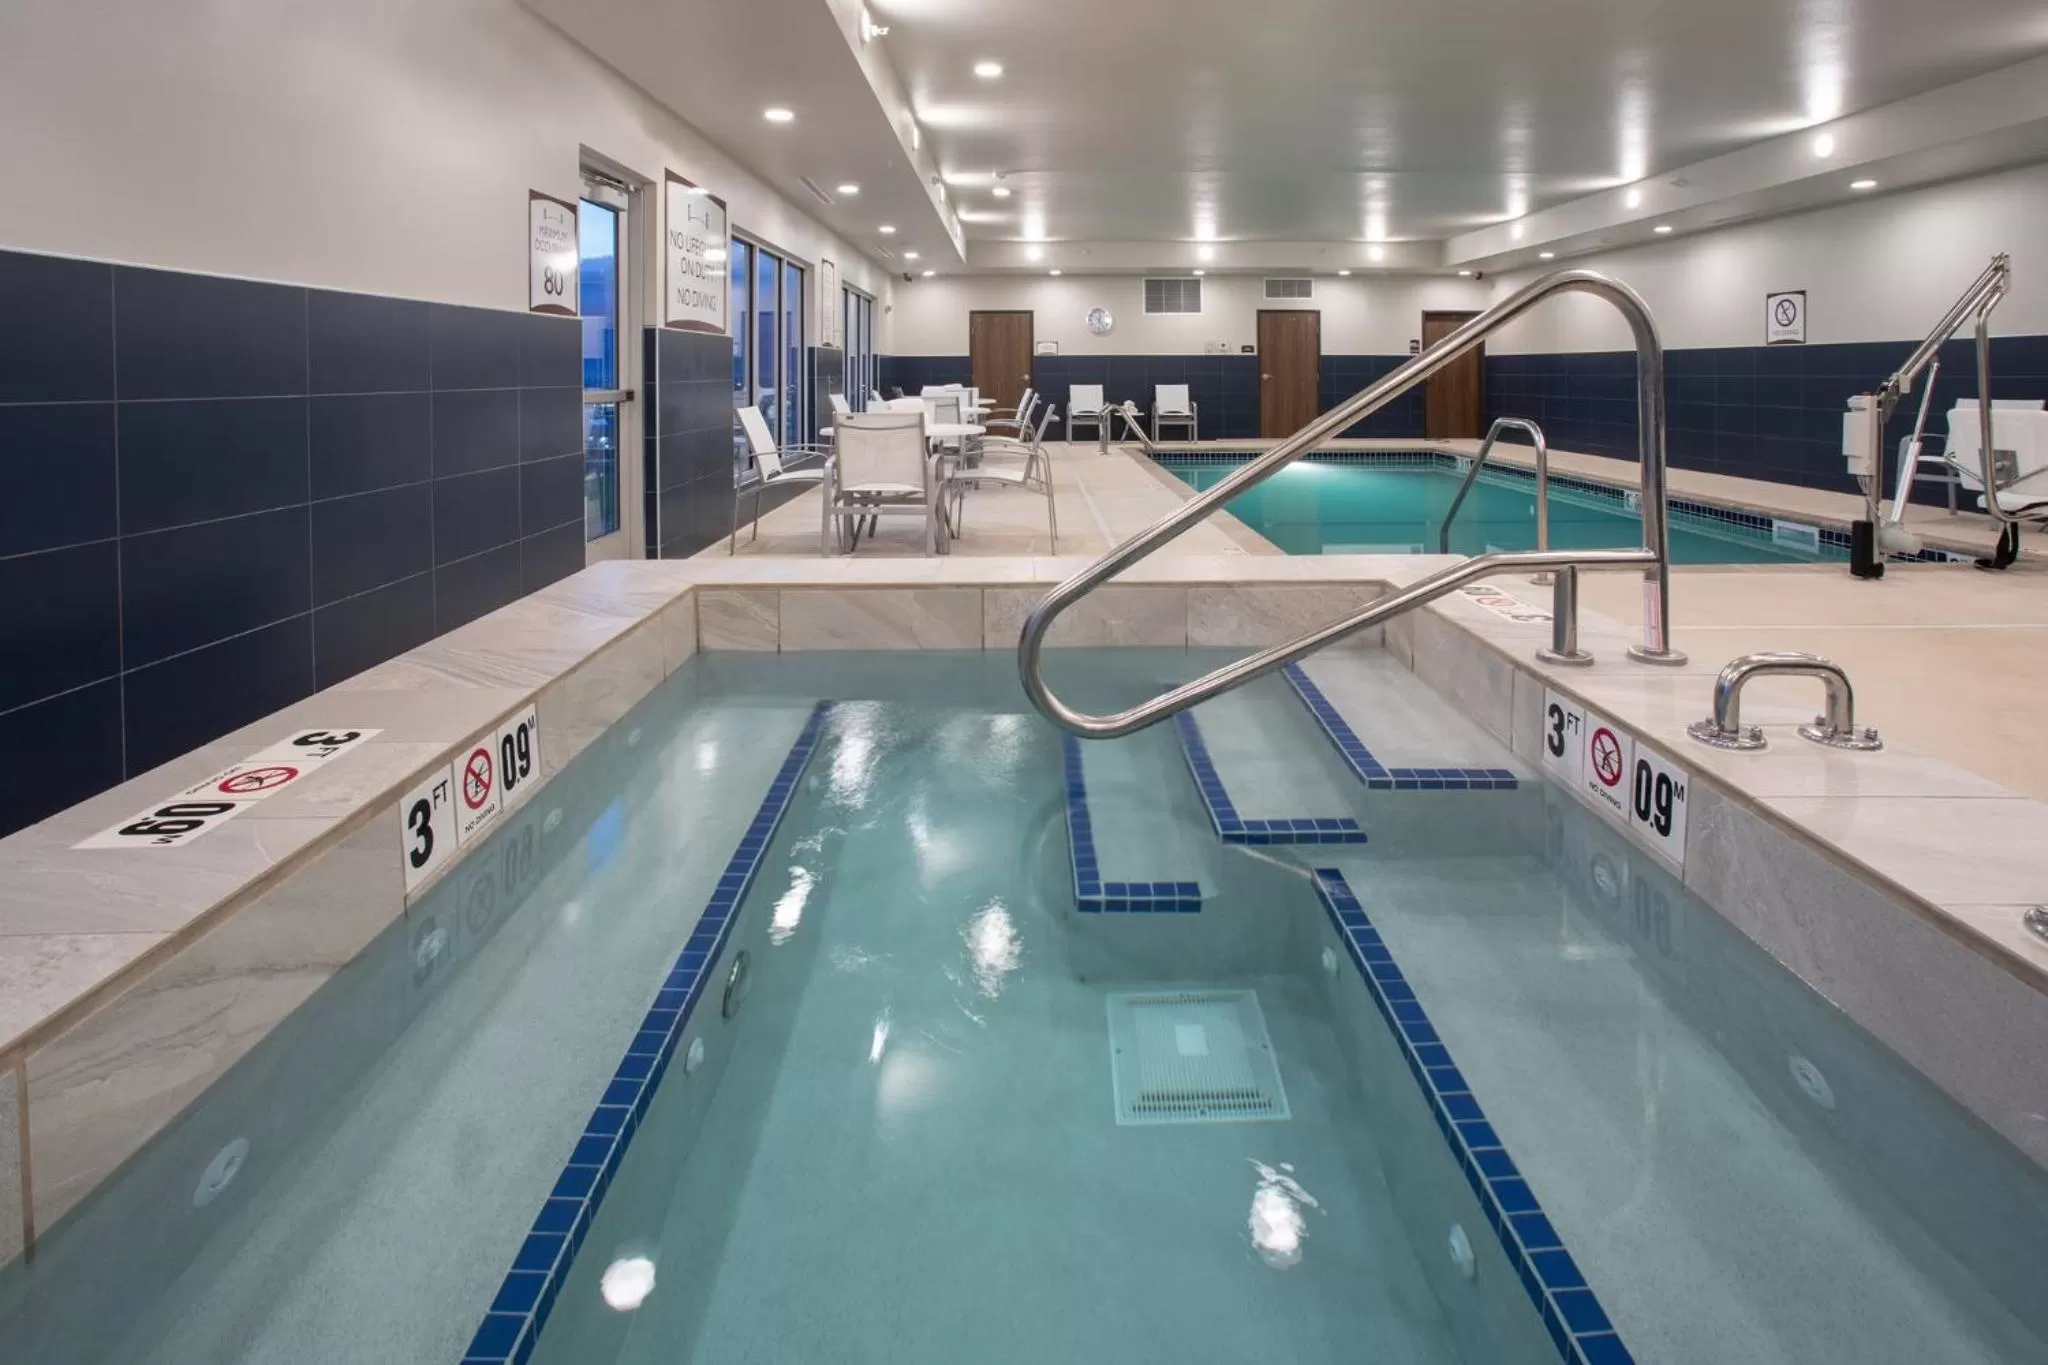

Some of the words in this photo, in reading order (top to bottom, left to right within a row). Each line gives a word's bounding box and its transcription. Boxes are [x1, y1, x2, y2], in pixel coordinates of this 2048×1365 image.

[670, 229, 684, 250] NO
[680, 256, 694, 277] ON
[544, 267, 564, 297] 80
[677, 287, 690, 307] NO
[692, 288, 717, 312] DIVING
[292, 731, 361, 747] 3
[1547, 703, 1565, 757] 3
[1566, 712, 1581, 736] FT
[501, 722, 531, 791] 0.9
[527, 714, 536, 730] M
[1588, 781, 1599, 794] NO
[1599, 790, 1622, 810] DIVING
[1634, 758, 1674, 838] 0.9
[1673, 780, 1685, 803] M
[408, 797, 434, 869] 3
[432, 779, 448, 810] FT
[464, 820, 476, 834] NO
[476, 803, 496, 826] DIVING
